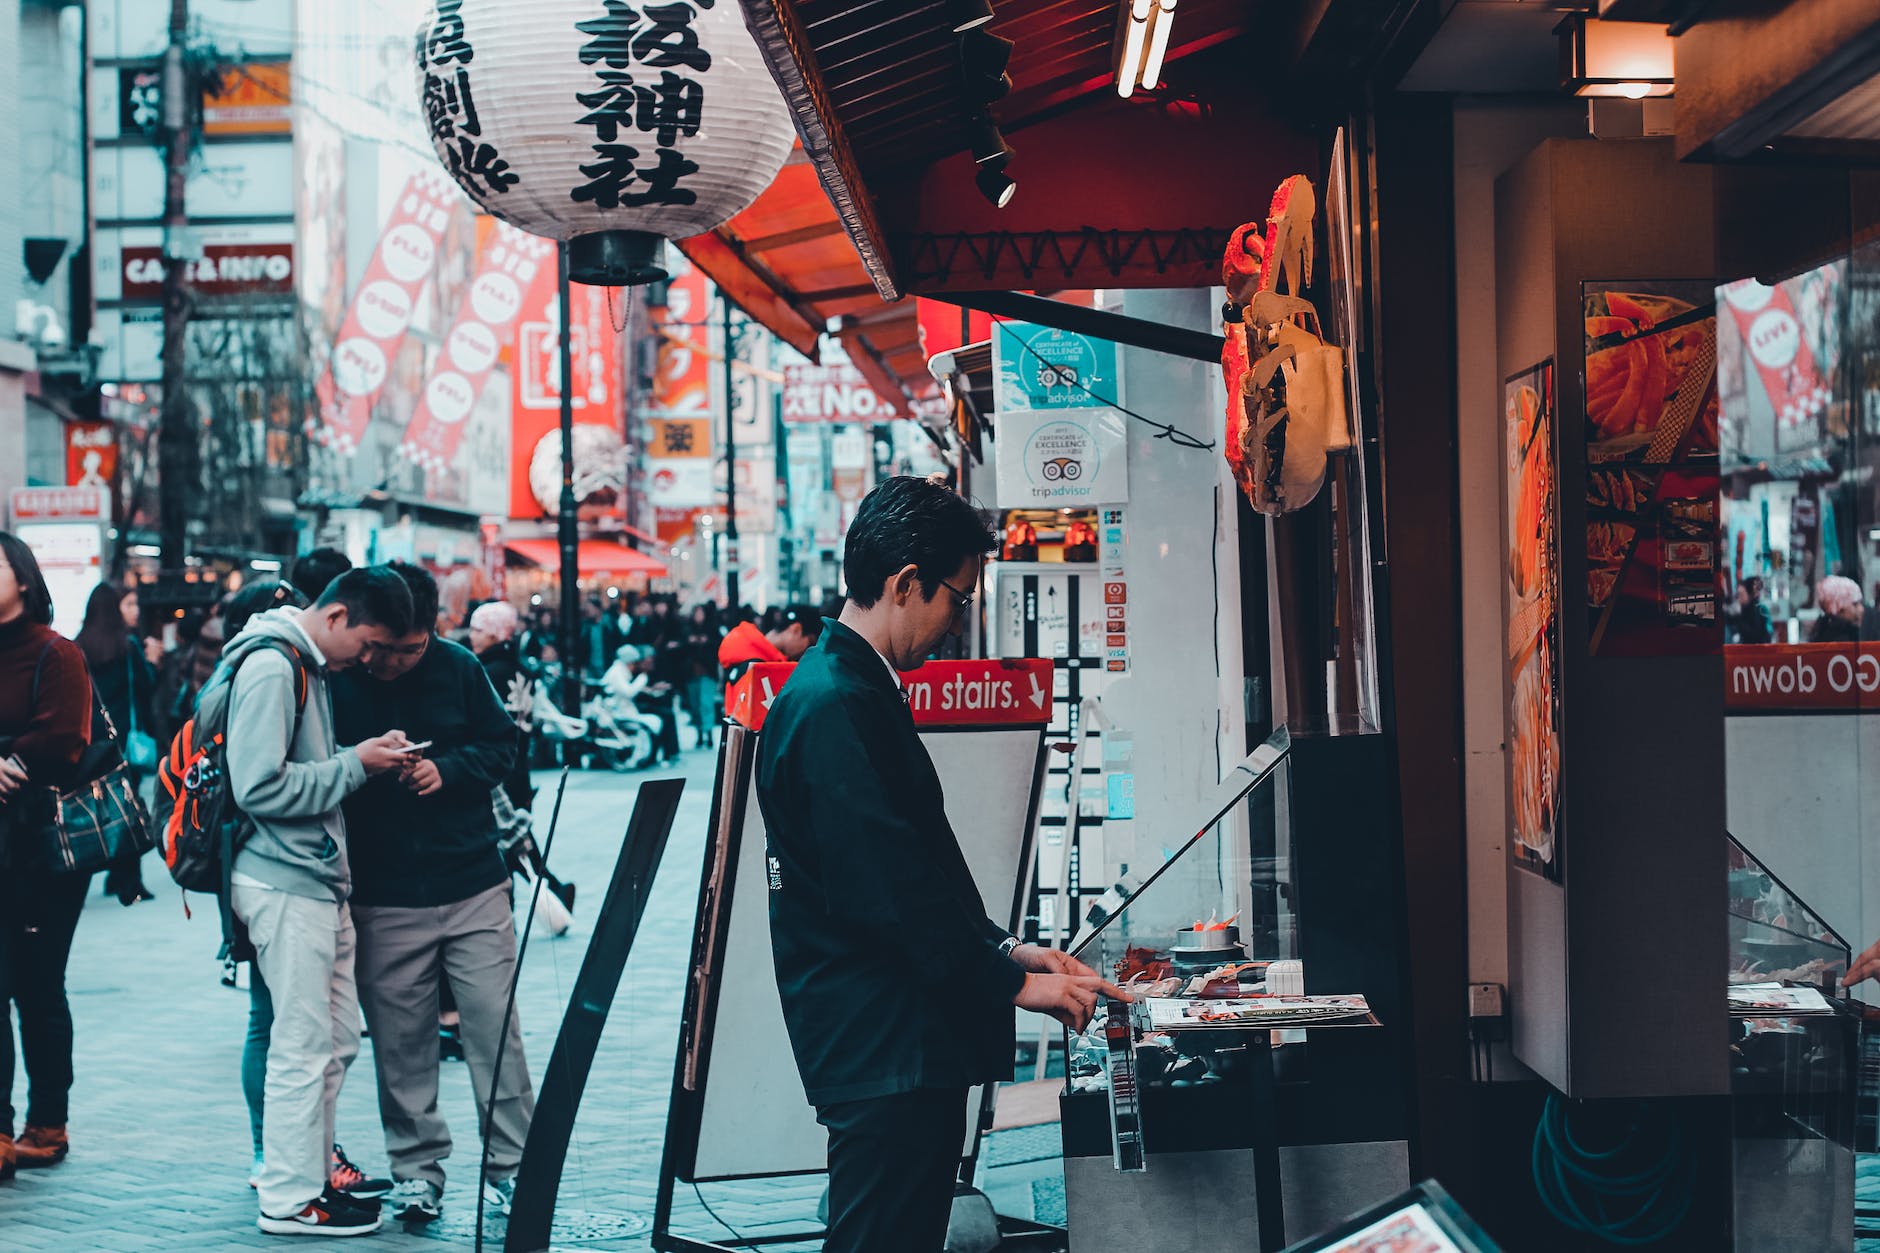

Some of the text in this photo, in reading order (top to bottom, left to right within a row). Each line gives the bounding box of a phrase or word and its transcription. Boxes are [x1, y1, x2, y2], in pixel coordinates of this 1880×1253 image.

[126, 258, 195, 284] CA
[1035, 440, 1087, 449] EXCELLENCE
[1032, 484, 1091, 498] tripadvisor
[1108, 649, 1126, 657] VISA
[941, 671, 1019, 710] stairs.
